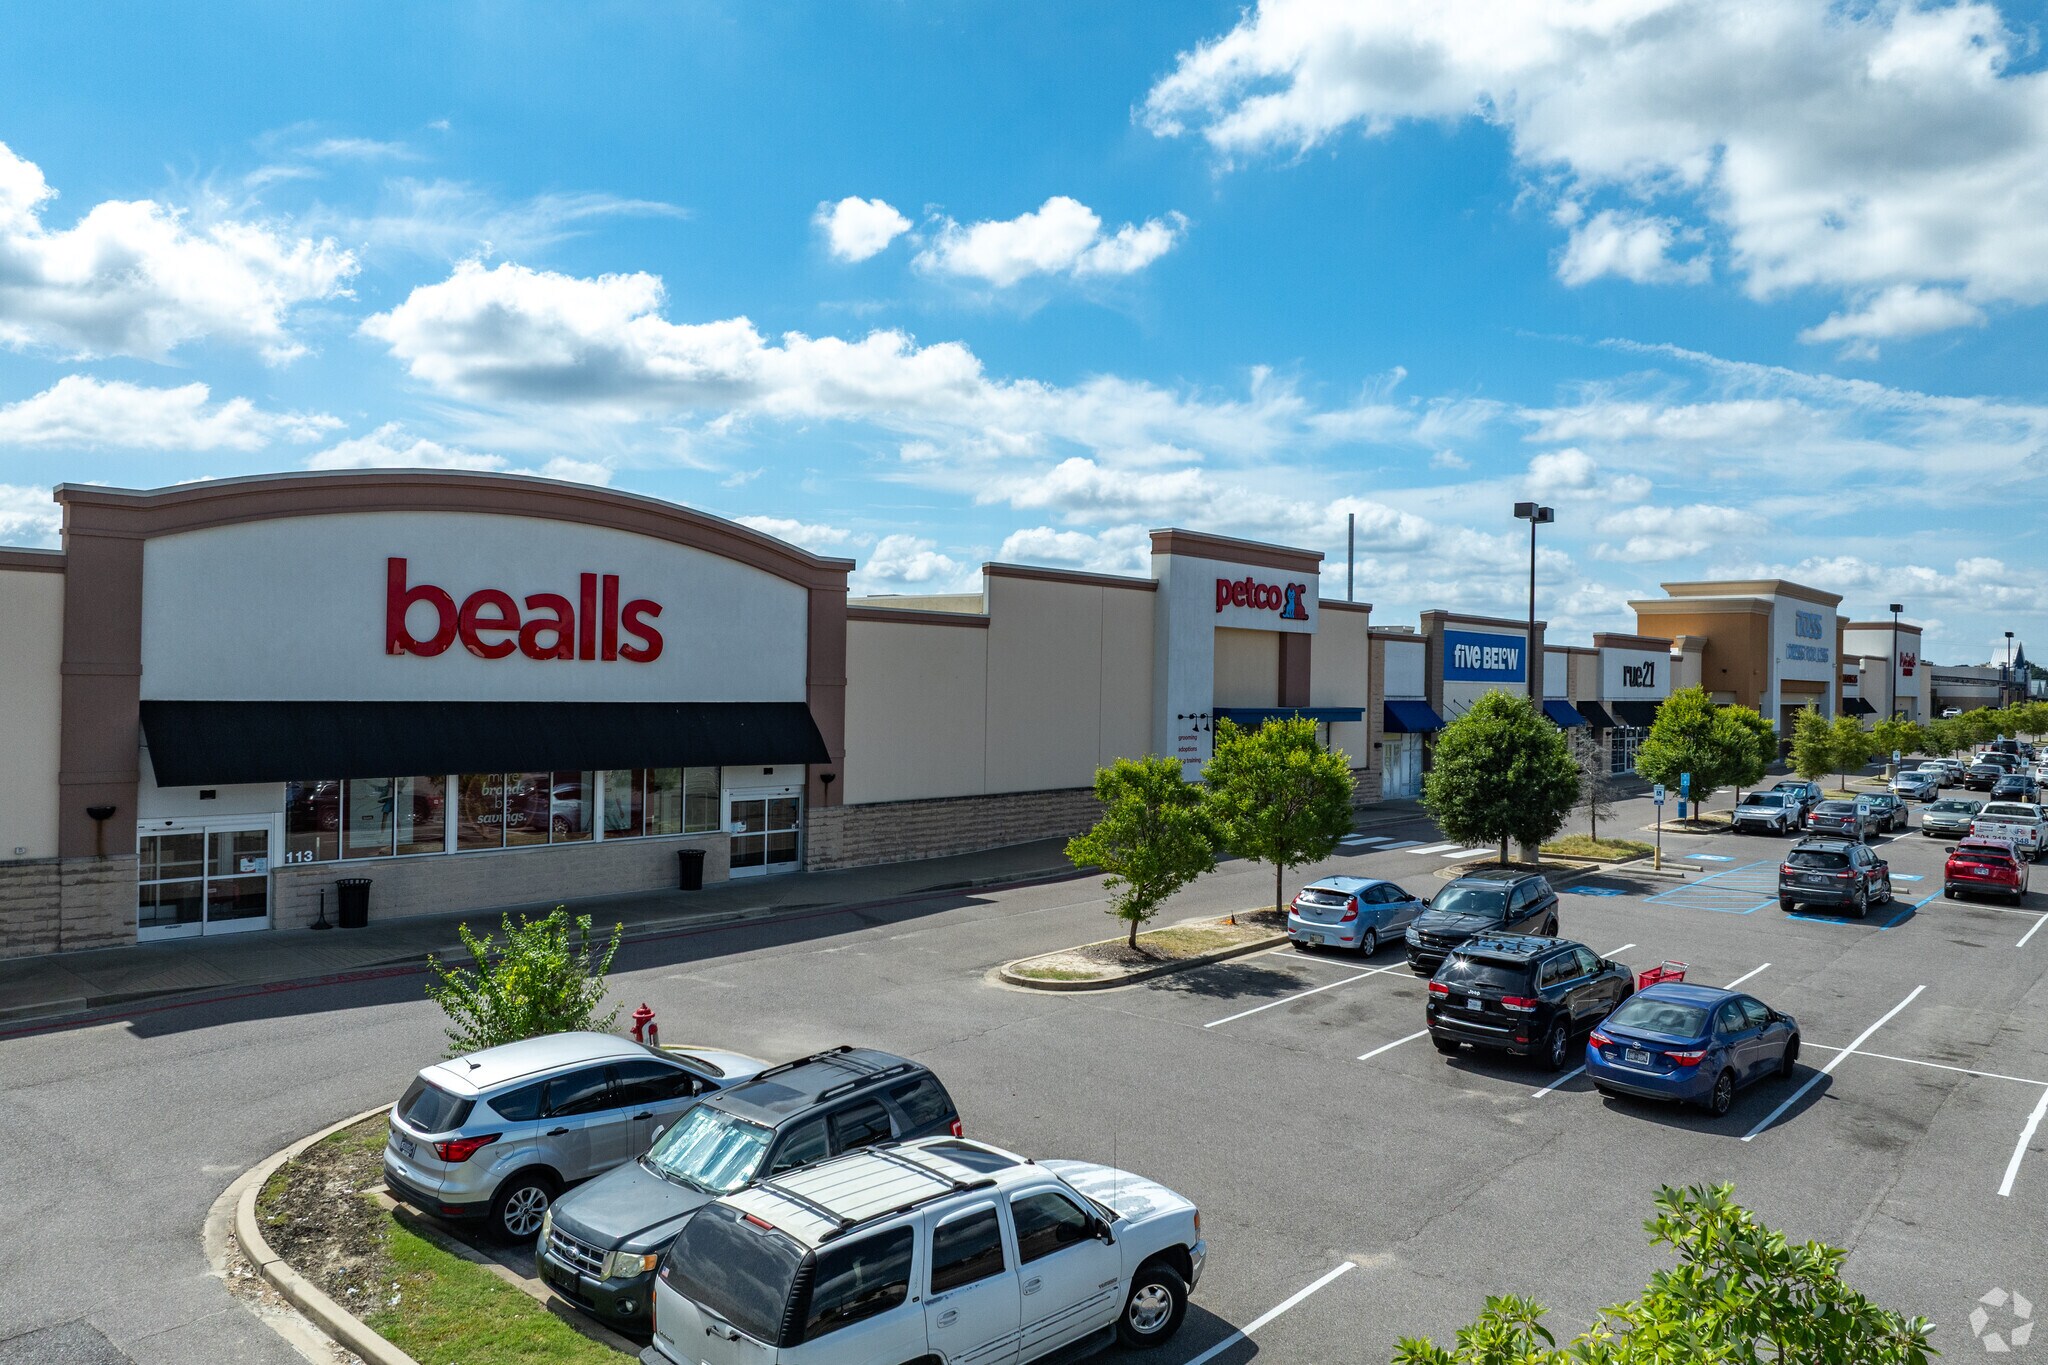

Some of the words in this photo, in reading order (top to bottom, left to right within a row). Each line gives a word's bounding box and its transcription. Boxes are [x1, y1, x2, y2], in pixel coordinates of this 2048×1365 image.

[1216, 577, 1283, 613] petco
[386, 556, 664, 663] bealls
[1455, 643, 1481, 669] five
[1623, 660, 1655, 687] rue21
[495, 795, 513, 813] bg
[286, 850, 313, 863] 113
